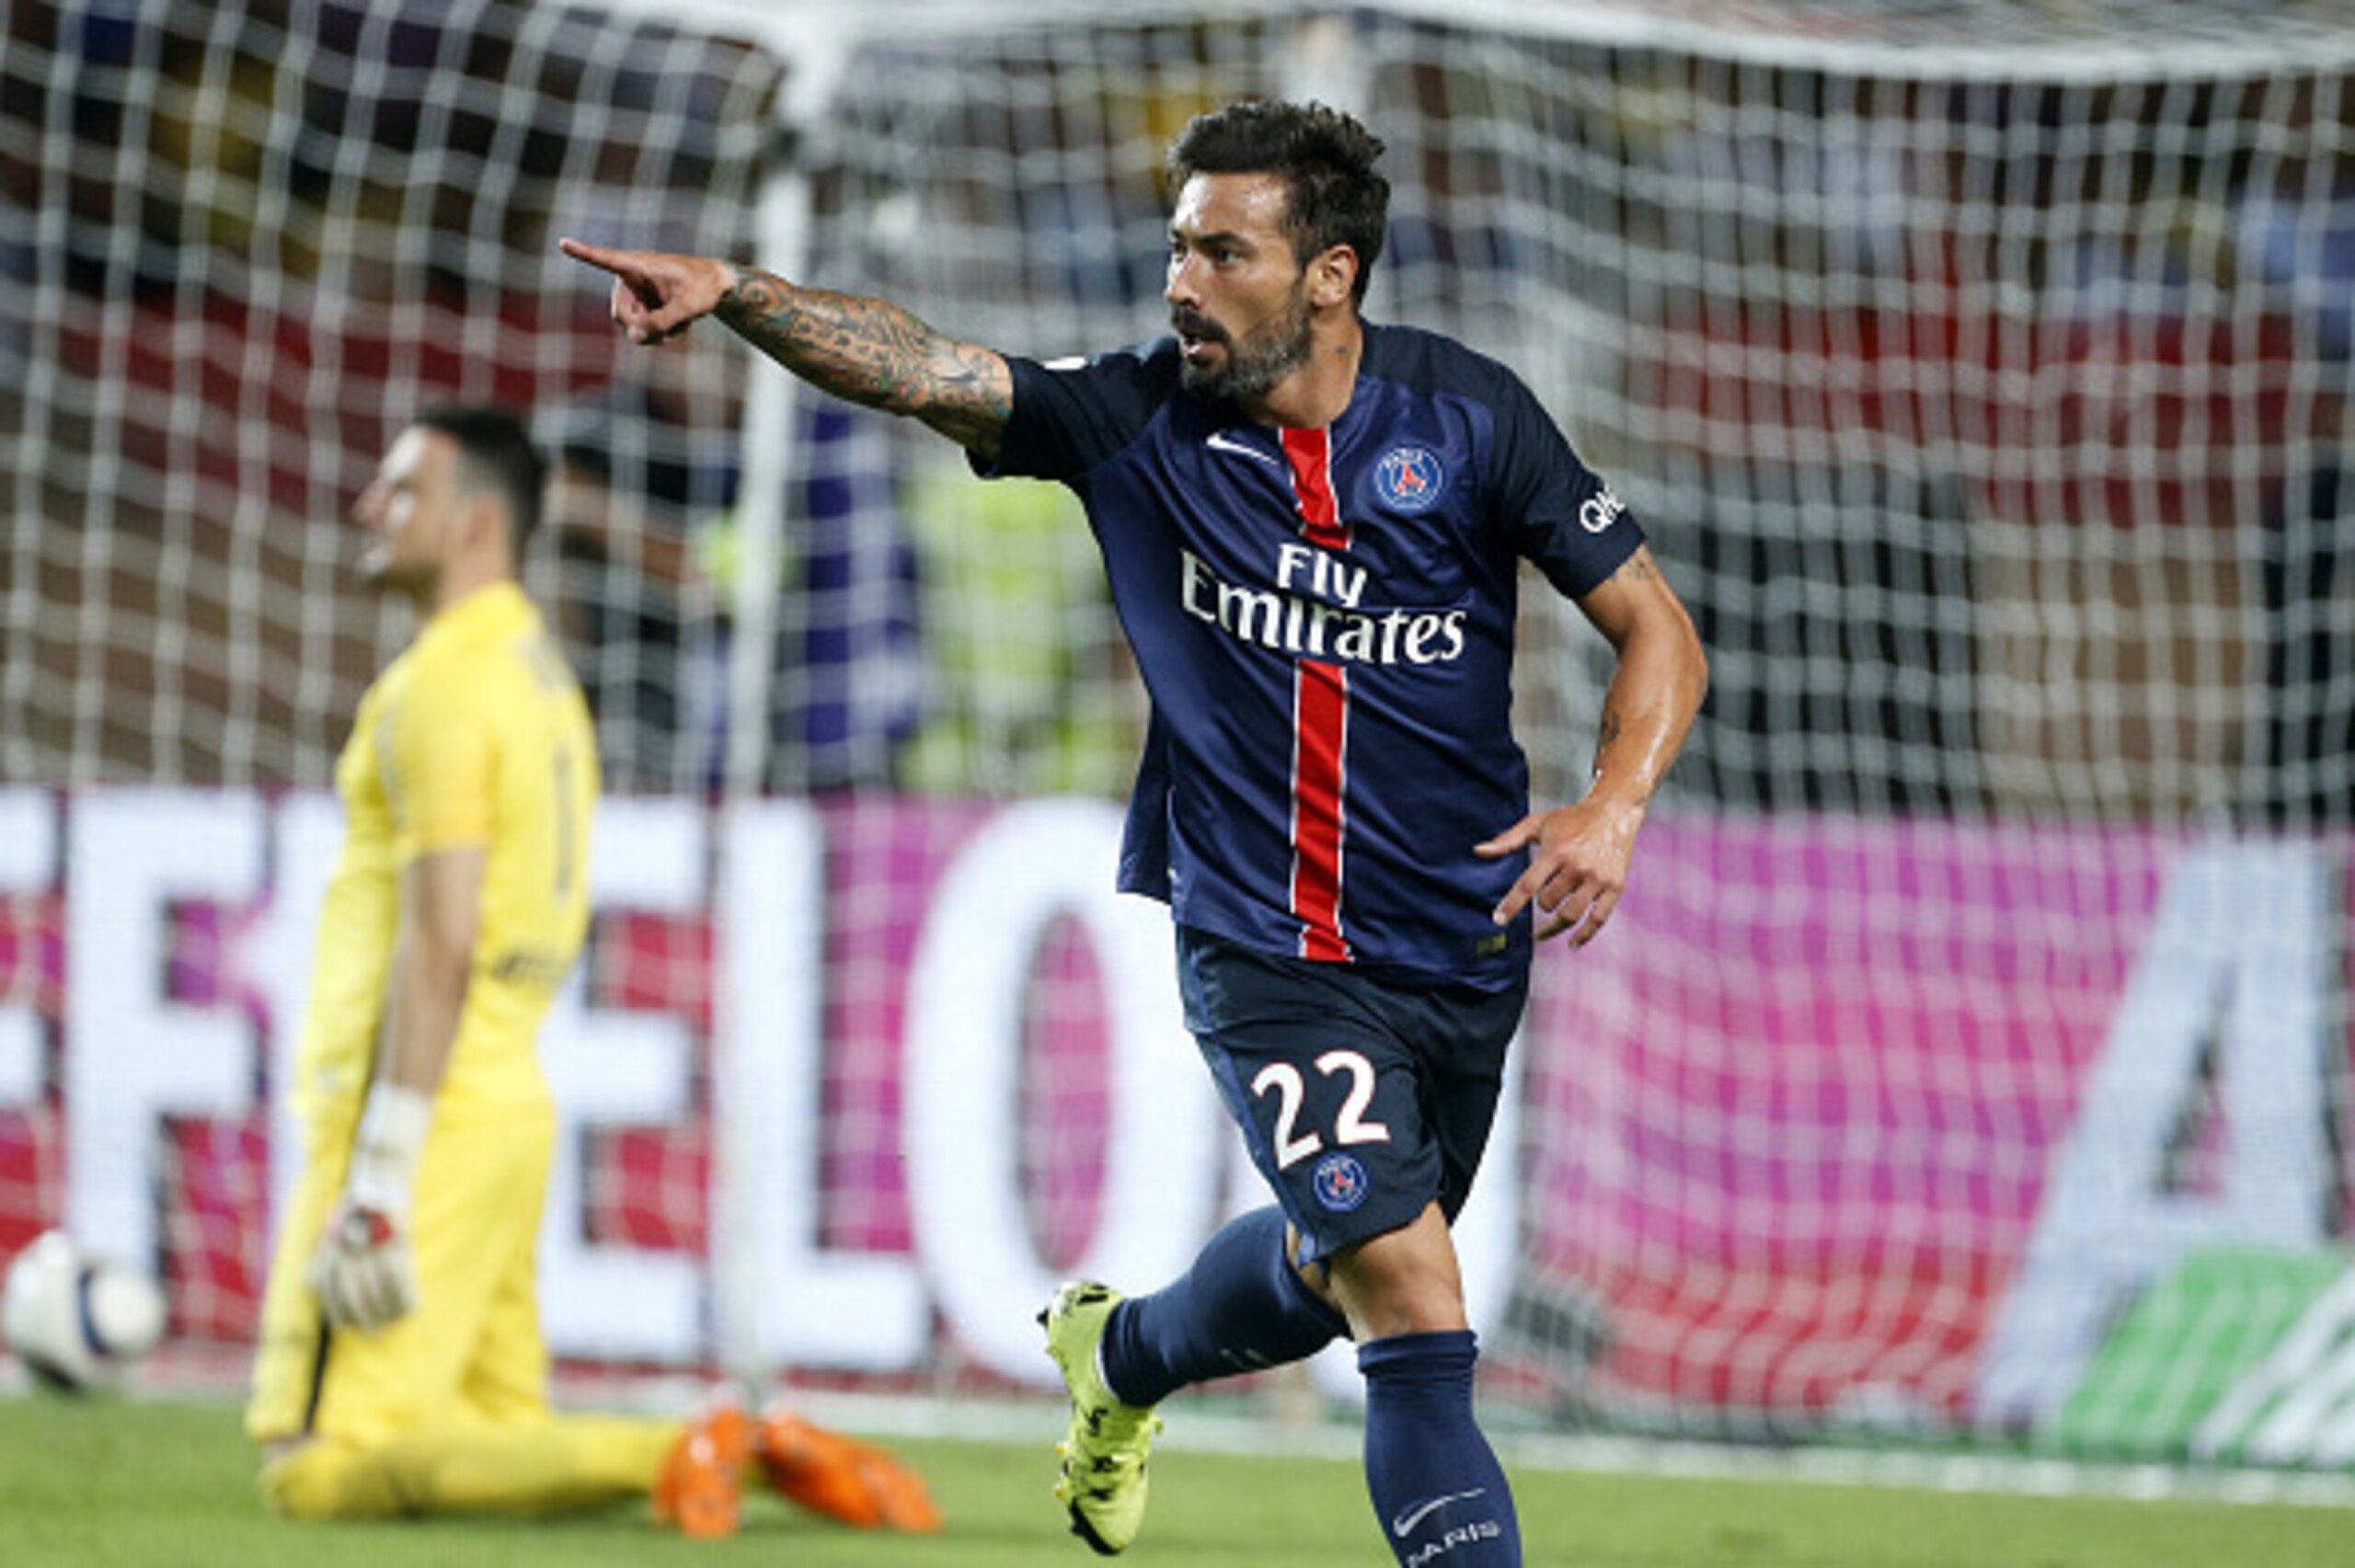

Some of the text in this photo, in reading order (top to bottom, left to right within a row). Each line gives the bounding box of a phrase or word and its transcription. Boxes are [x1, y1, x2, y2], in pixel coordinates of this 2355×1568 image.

[1181, 548, 1467, 664] Emirates
[1277, 543, 1368, 608] Fly
[1249, 1047, 1392, 1171] 22
